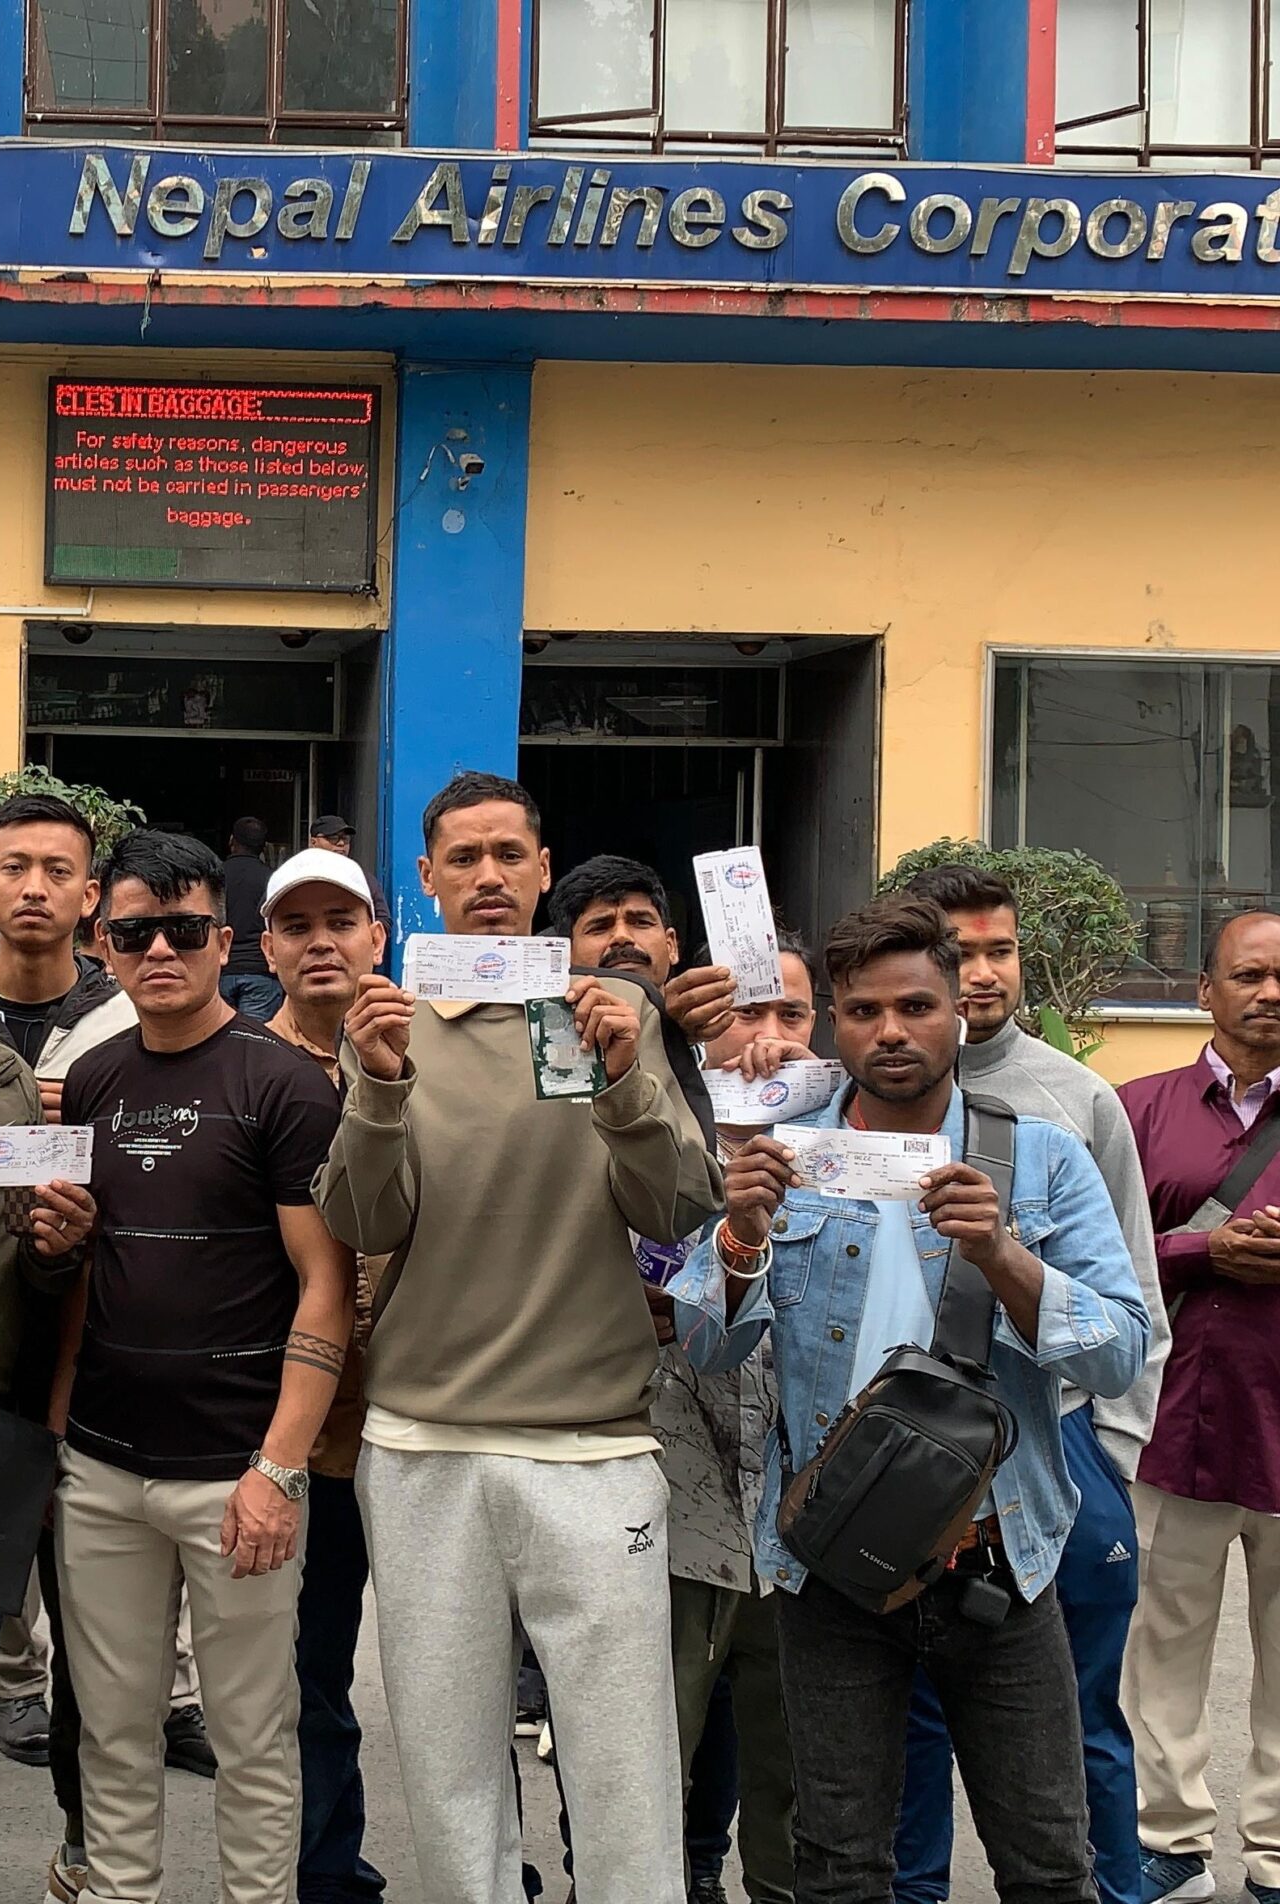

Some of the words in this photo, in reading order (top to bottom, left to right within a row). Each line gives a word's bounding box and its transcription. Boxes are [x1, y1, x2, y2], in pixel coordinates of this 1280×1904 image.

[68, 153, 372, 259] Nepal
[391, 161, 795, 250] Airlines
[120, 392, 142, 415] IN
[149, 391, 264, 417] BAGGAGE:
[76, 431, 106, 449] For
[112, 433, 164, 454] safety
[169, 436, 246, 455] reasons,
[252, 436, 348, 458] dangerous
[55, 453, 119, 470] articles
[125, 455, 167, 471] such
[174, 459, 194, 473] as
[198, 456, 249, 474] those
[255, 458, 303, 475] listed
[309, 460, 368, 479] below,
[54, 475, 97, 491] must
[102, 477, 132, 493] not
[137, 477, 160, 493] be
[166, 479, 228, 495] carried
[234, 482, 252, 495] in
[167, 508, 251, 528] baggage.
[858, 1547, 897, 1573] FASHION
[1106, 1552, 1132, 1563] adidas
